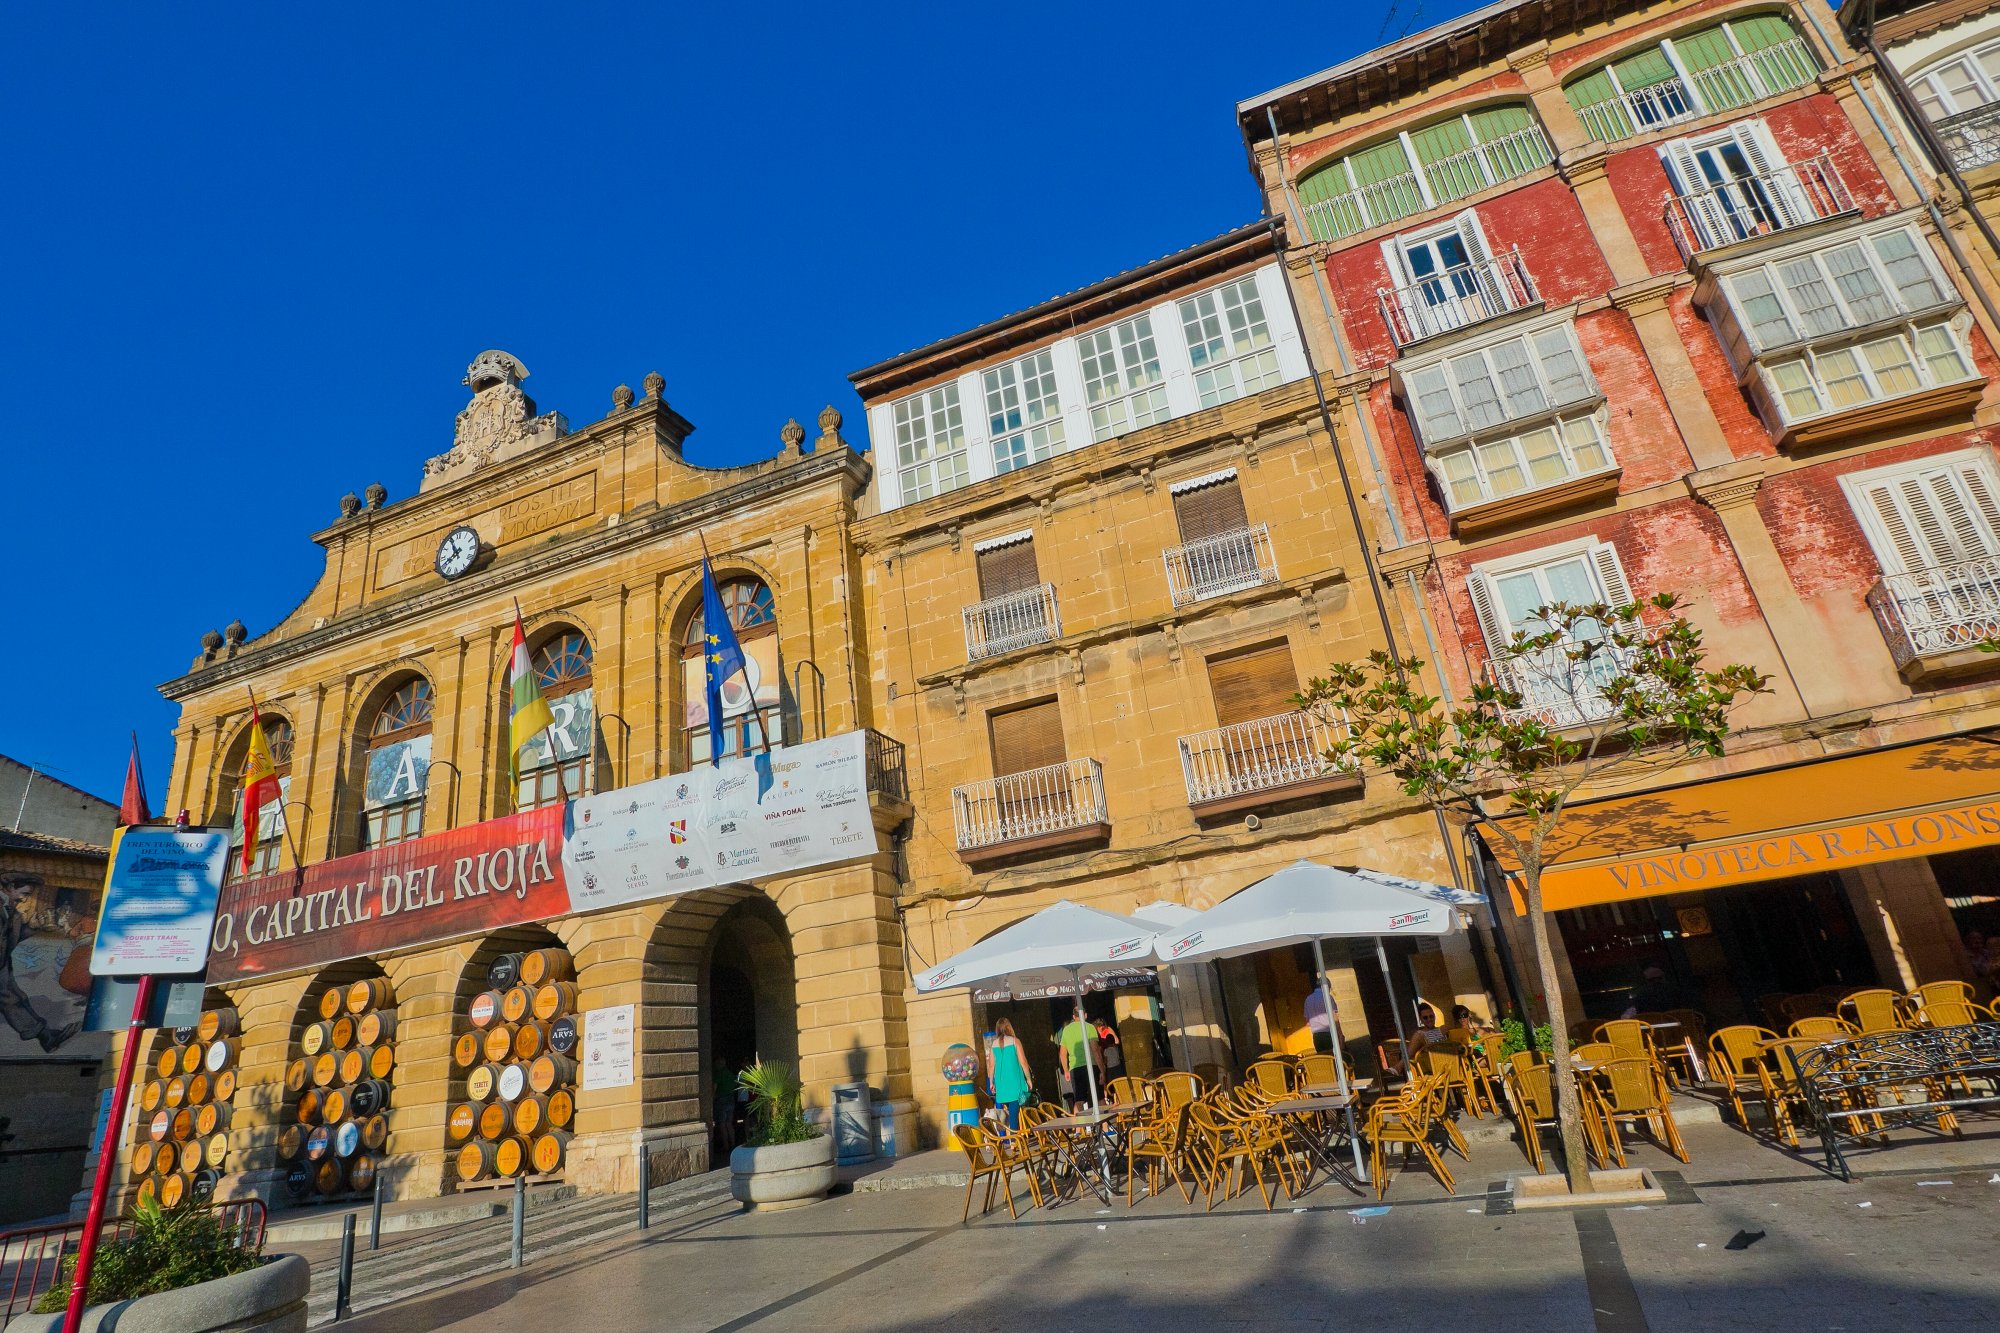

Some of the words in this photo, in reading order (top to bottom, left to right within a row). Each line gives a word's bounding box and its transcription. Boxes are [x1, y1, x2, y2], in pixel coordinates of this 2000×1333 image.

[384, 746, 419, 800] A
[764, 811, 781, 821] VIÑA
[782, 806, 807, 818] POMAL
[154, 840, 203, 848] TURÍSTICO
[830, 832, 864, 846] TERETE
[161, 848, 185, 856] VINO
[1605, 840, 1815, 891] VINOTECA
[246, 882, 372, 945] CAPITAL
[380, 864, 444, 917] DEL
[453, 838, 555, 900] RIOJA
[1090, 967, 1141, 980] MAGNUM
[1059, 984, 1084, 993] MAGNM
